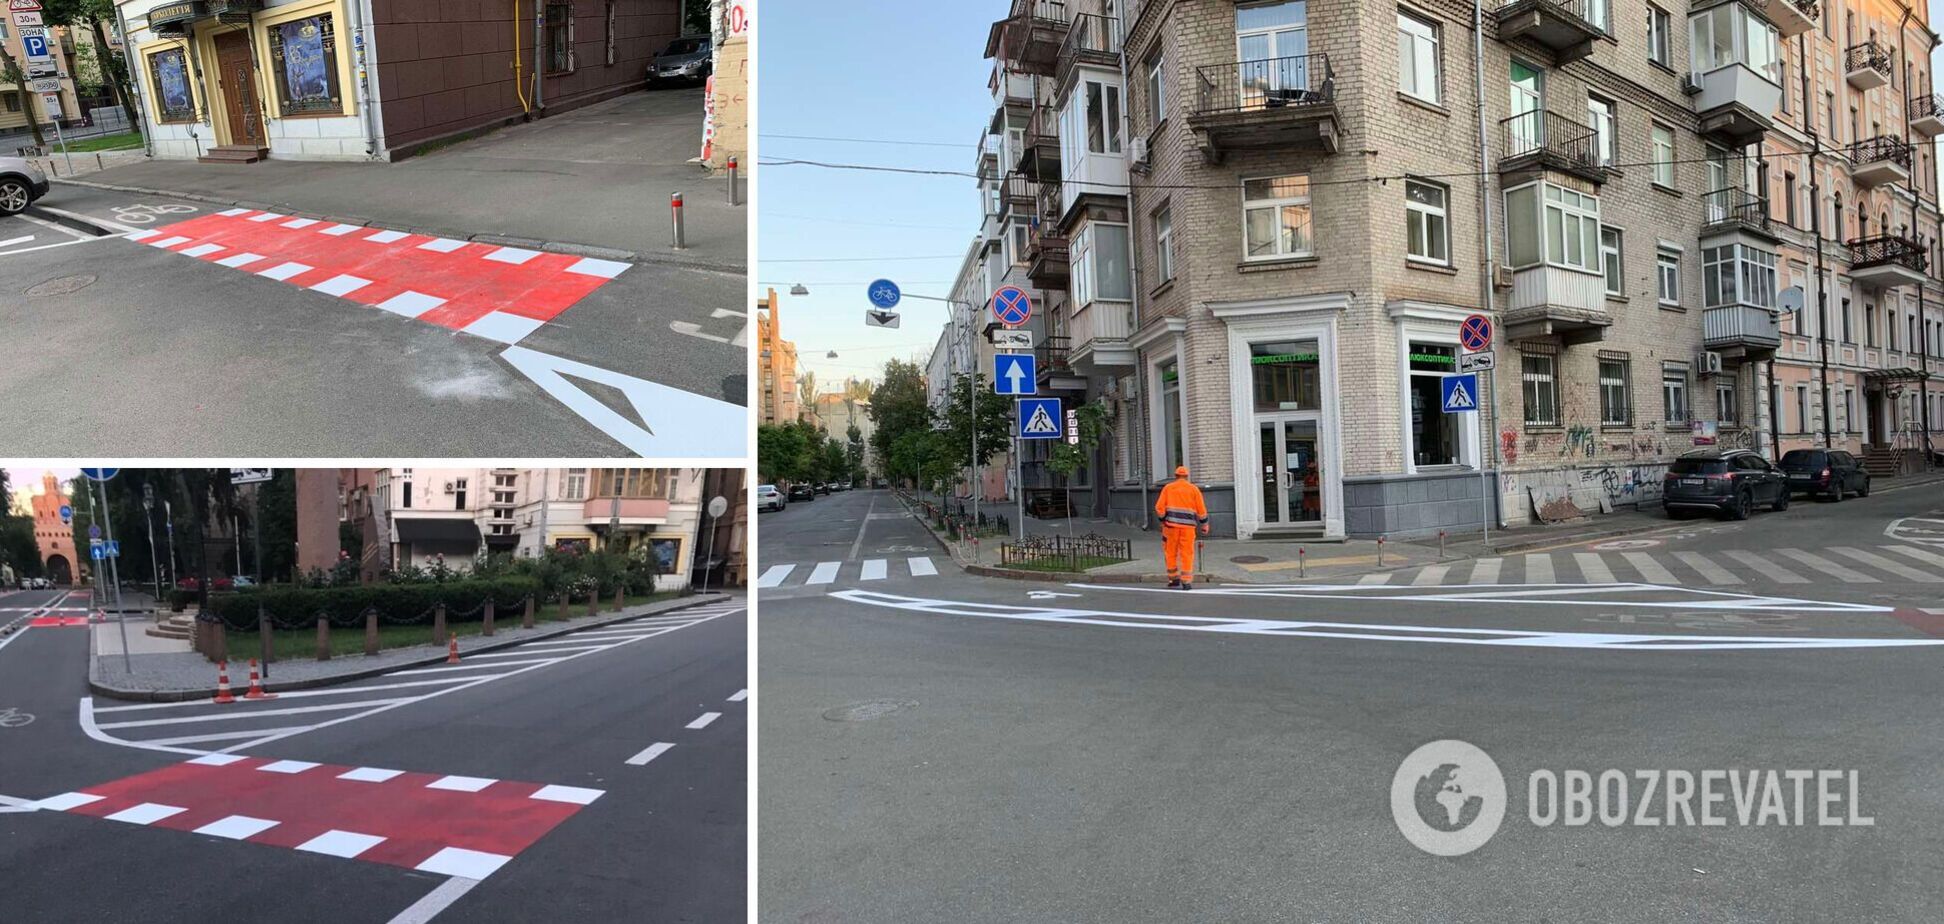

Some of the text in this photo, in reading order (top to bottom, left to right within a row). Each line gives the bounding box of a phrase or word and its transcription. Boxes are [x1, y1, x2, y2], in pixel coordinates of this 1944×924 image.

[20, 15, 30, 23] 30
[20, 28, 43, 37] ЗОНА
[29, 38, 43, 55] P
